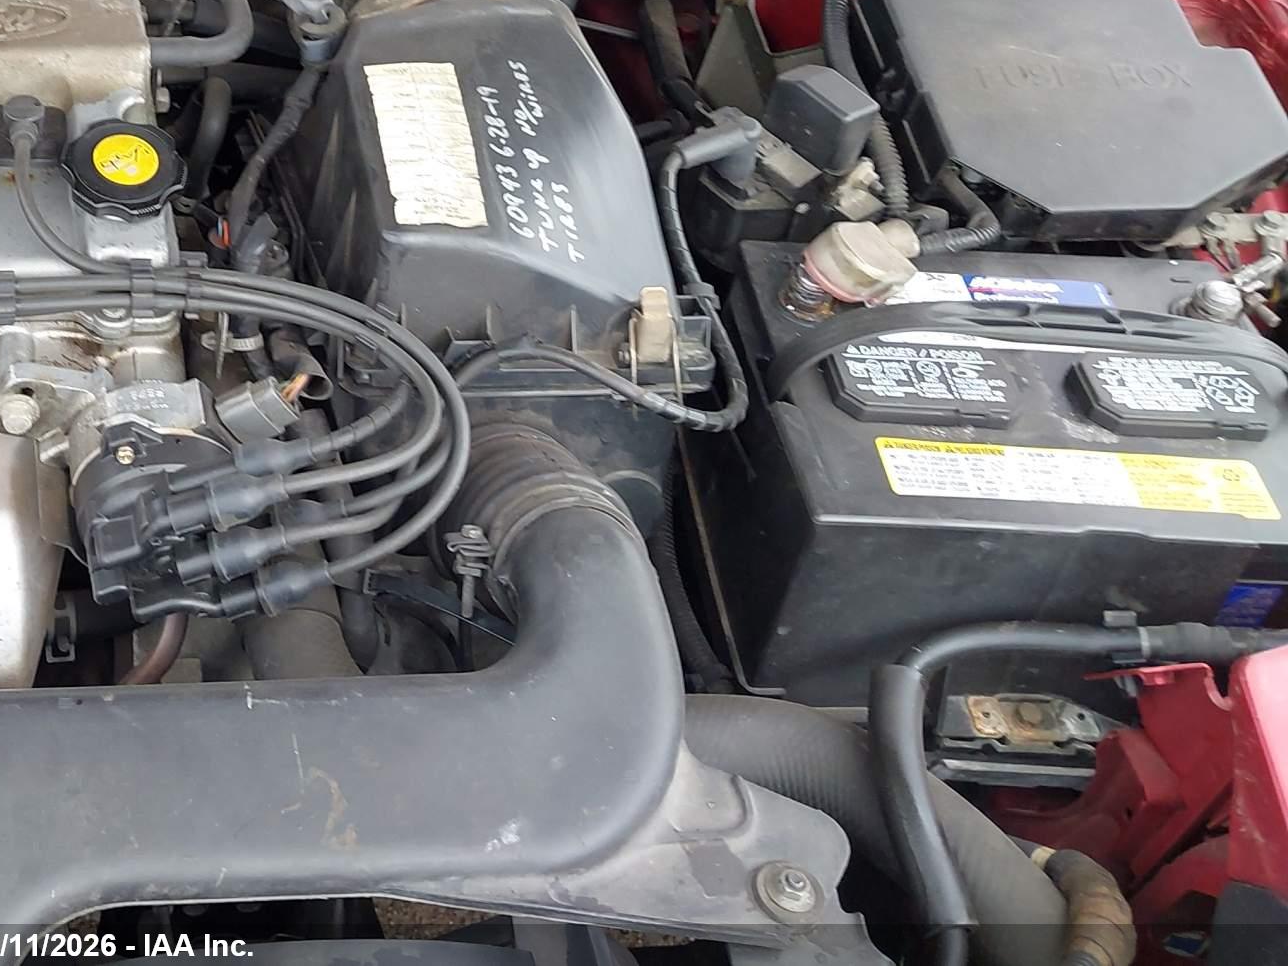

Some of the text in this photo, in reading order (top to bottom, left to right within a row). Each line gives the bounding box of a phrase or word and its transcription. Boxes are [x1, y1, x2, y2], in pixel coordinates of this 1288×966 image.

[973, 62, 1193, 90] FUSE BOX
[858, 345, 918, 359] DANGER
[929, 348, 985, 362] POISON
